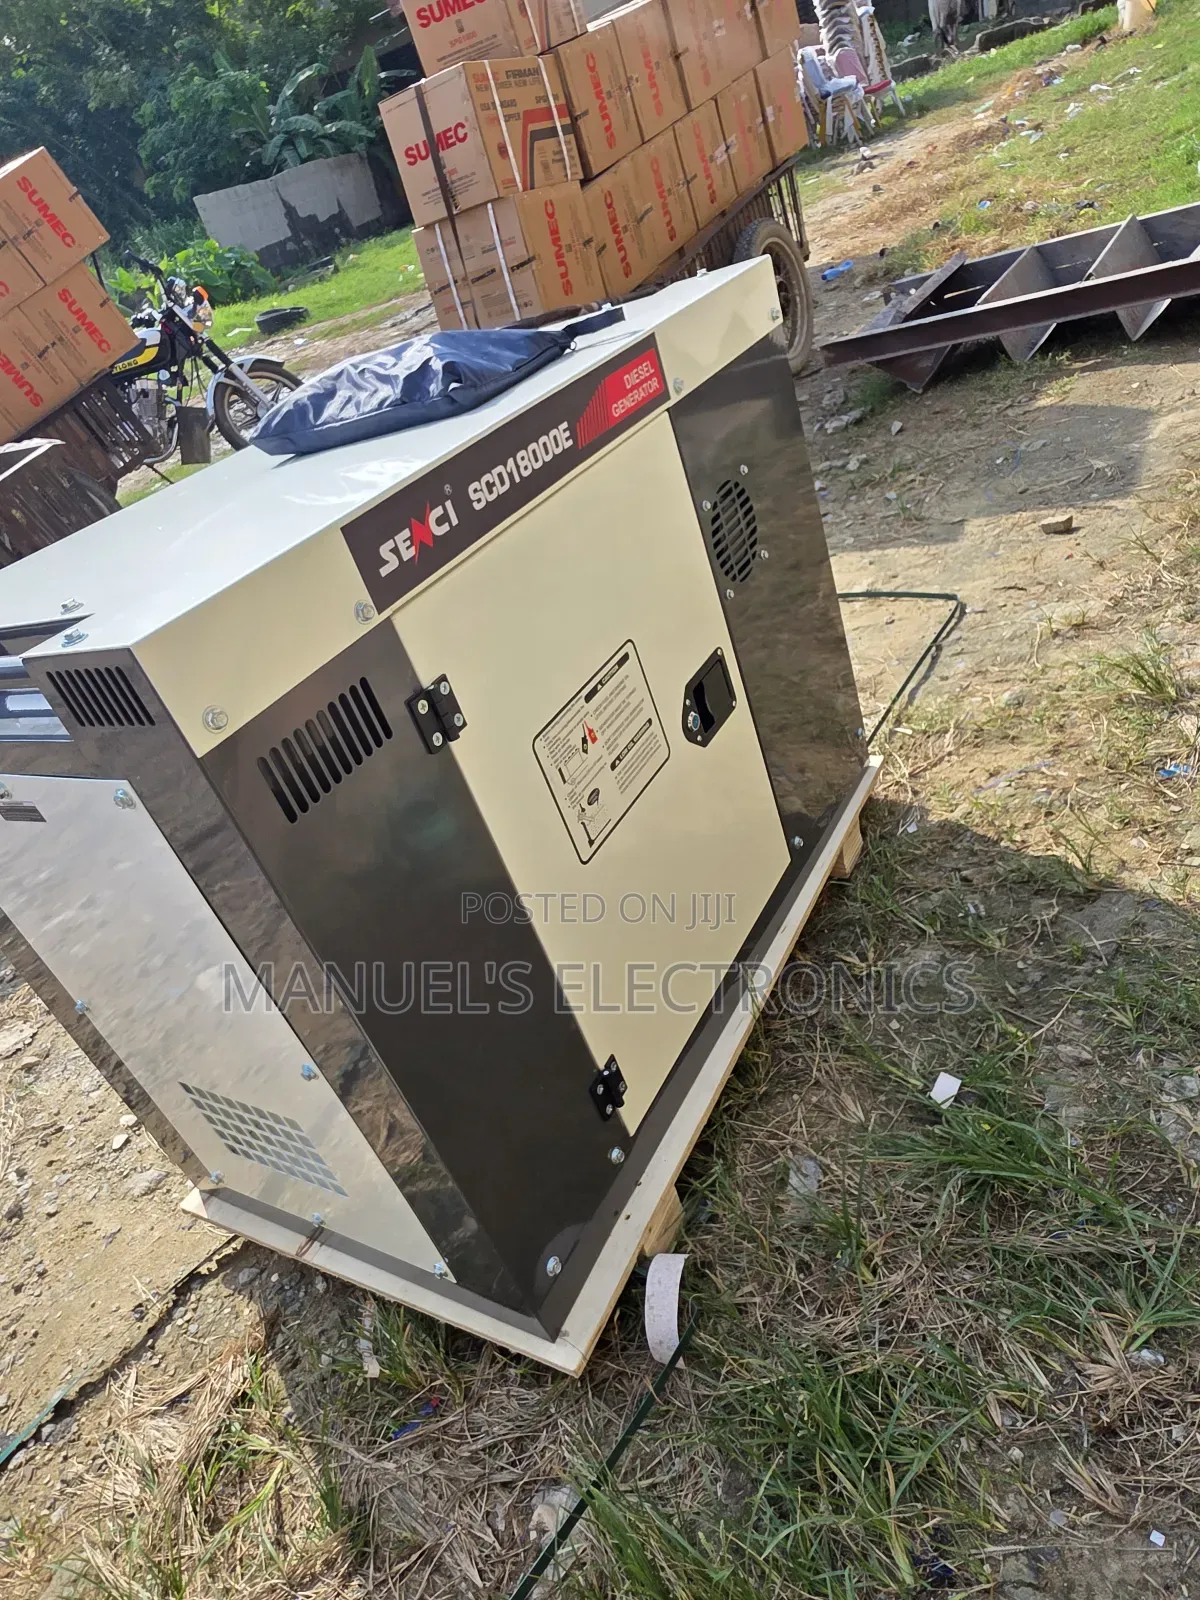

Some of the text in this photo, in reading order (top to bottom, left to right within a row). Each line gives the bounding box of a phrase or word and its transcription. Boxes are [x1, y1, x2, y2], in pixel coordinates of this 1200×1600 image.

[585, 51, 616, 150] SUMEC
[651, 156, 677, 242] SUMEC
[693, 119, 717, 204] SUMEC
[16, 176, 76, 248] SUMEC
[544, 199, 574, 297] SUMEC
[604, 190, 632, 279] SUMEC
[57, 288, 111, 353] SUMEC
[611, 377, 660, 417] GENERATOR
[624, 360, 655, 389] DIESEL
[378, 420, 573, 578] SENCI SCD18000E
